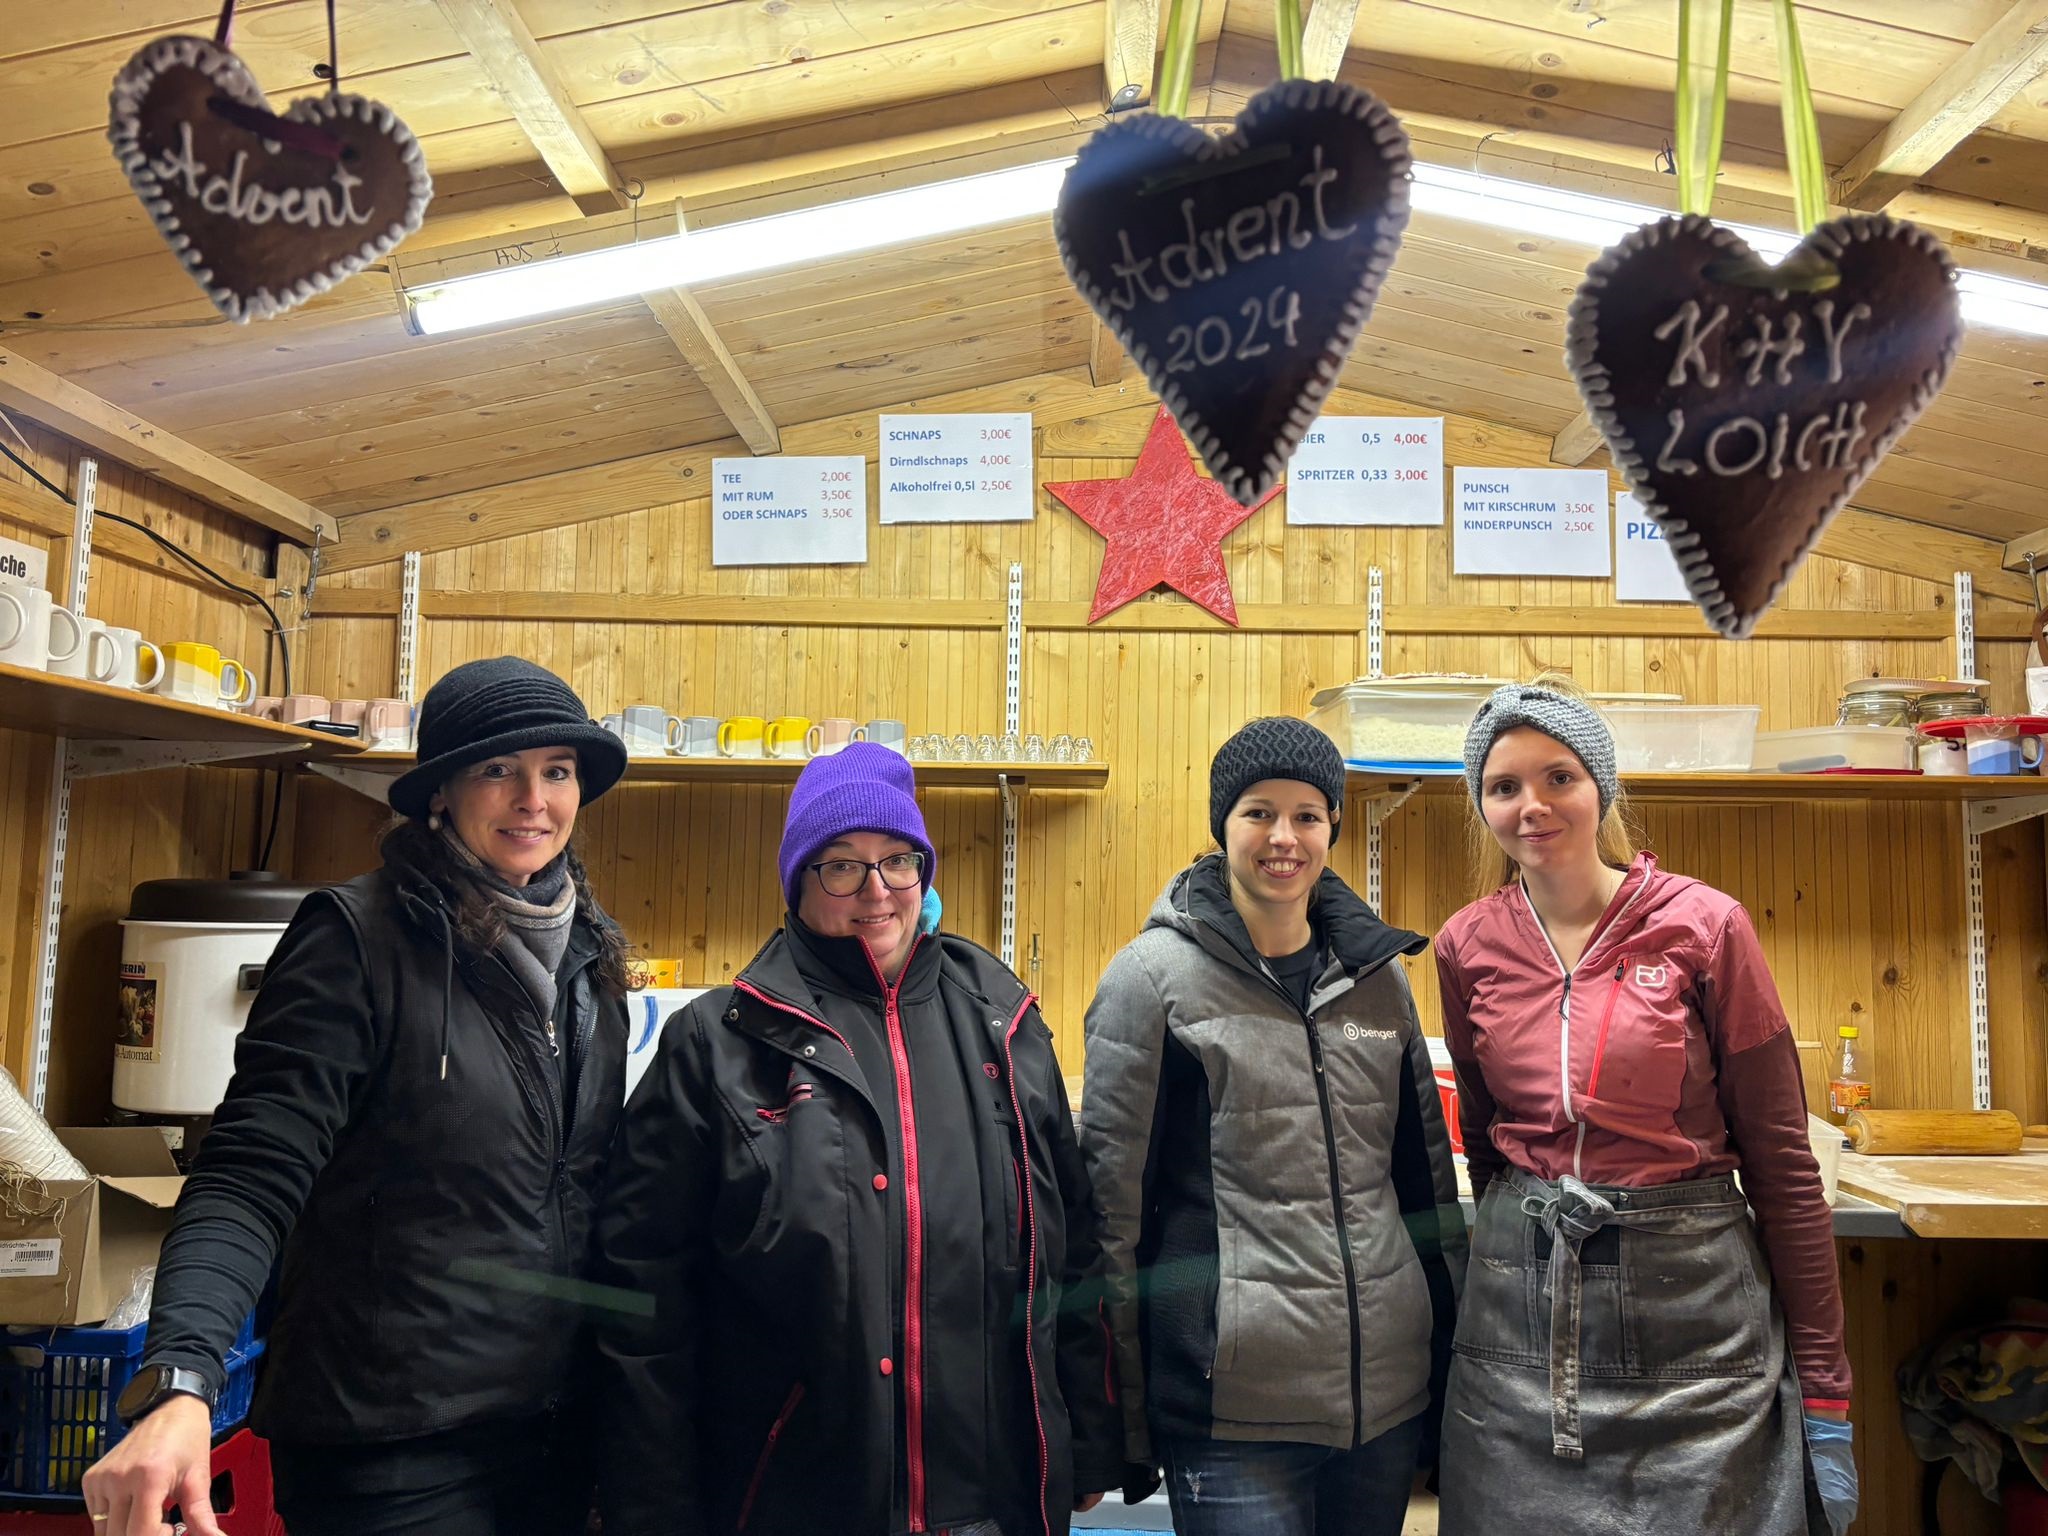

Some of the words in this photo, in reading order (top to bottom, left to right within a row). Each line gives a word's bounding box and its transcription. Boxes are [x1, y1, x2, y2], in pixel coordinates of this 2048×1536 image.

[153, 121, 375, 228] Advent
[1110, 144, 1358, 311] Advent
[1166, 285, 1301, 372] 2024
[889, 430, 942, 441] SCHNAPS
[980, 429, 1012, 441] 3,00€
[1361, 433, 1381, 445] 0,5
[1394, 433, 1429, 445] 4,00€
[1656, 400, 1868, 480] LOICH
[889, 456, 969, 467] Dirndlschnaps
[980, 454, 1012, 466] 4,00€
[722, 473, 742, 484] TEE
[821, 471, 853, 483] 2,00€
[1297, 469, 1355, 481] SPRITZER
[1361, 469, 1388, 482] 0,33
[1394, 469, 1429, 482] 3,00€
[889, 481, 952, 492] Alkoholfrei
[954, 480, 976, 492] 0,5l
[980, 480, 1013, 492] 2,50€
[1463, 483, 1509, 494] PUNSCH
[722, 492, 744, 502] MIT
[747, 491, 774, 501] RUM
[821, 489, 853, 501] 3,50€
[722, 510, 754, 521] ODER
[756, 508, 808, 520] SCHNAPS
[822, 507, 854, 519] 3,50€
[1463, 502, 1484, 512] MIT
[1488, 502, 1556, 513] KIRSCHRUM
[1565, 503, 1595, 514] 3,50€
[1464, 520, 1552, 531] KINDERPUNSCH
[1564, 521, 1594, 533] 2,50€
[1360, 1027, 1397, 1040] benger
